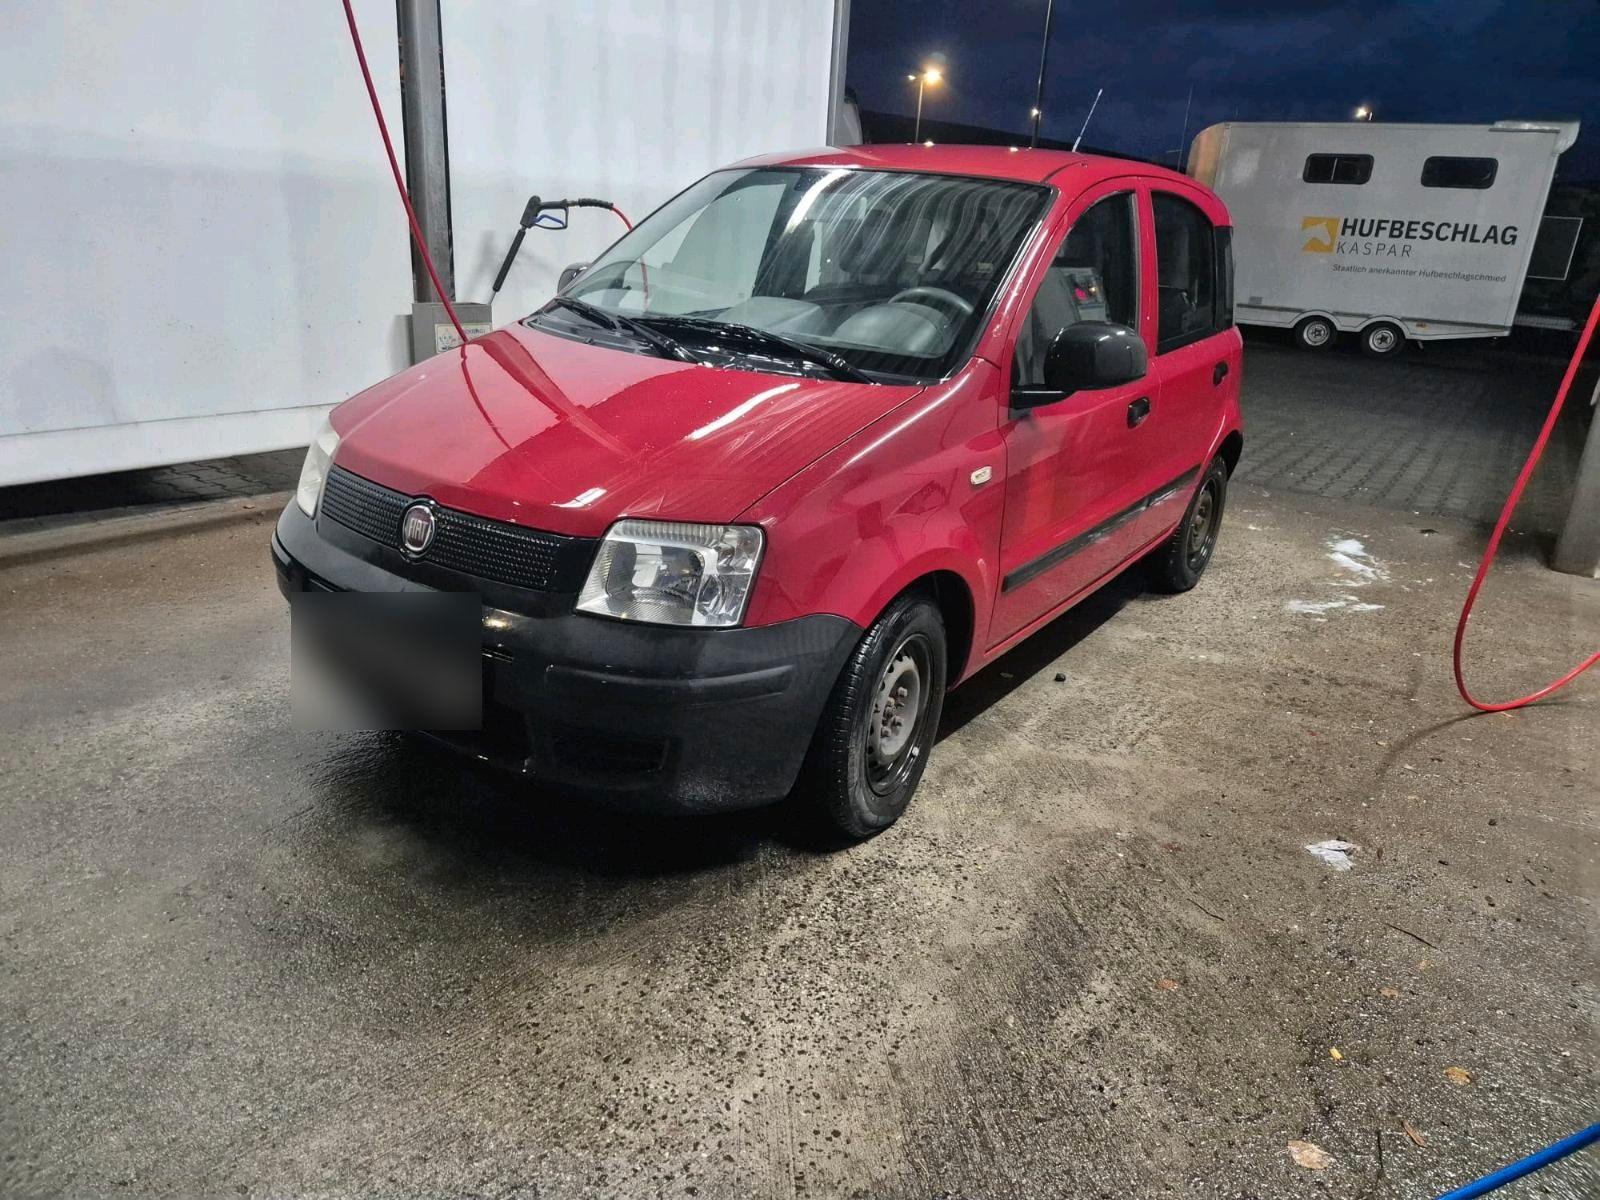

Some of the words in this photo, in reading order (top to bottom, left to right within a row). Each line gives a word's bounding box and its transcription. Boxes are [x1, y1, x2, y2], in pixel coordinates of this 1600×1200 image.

[1340, 218, 1518, 246] HUFBESCHLAG
[1337, 241, 1412, 258] KASPAR
[1332, 263, 1367, 273] Staatlich
[1369, 265, 1417, 276] anerkannter
[1419, 269, 1507, 283] Hufbeschlagschmied
[408, 518, 429, 541] FIAT
